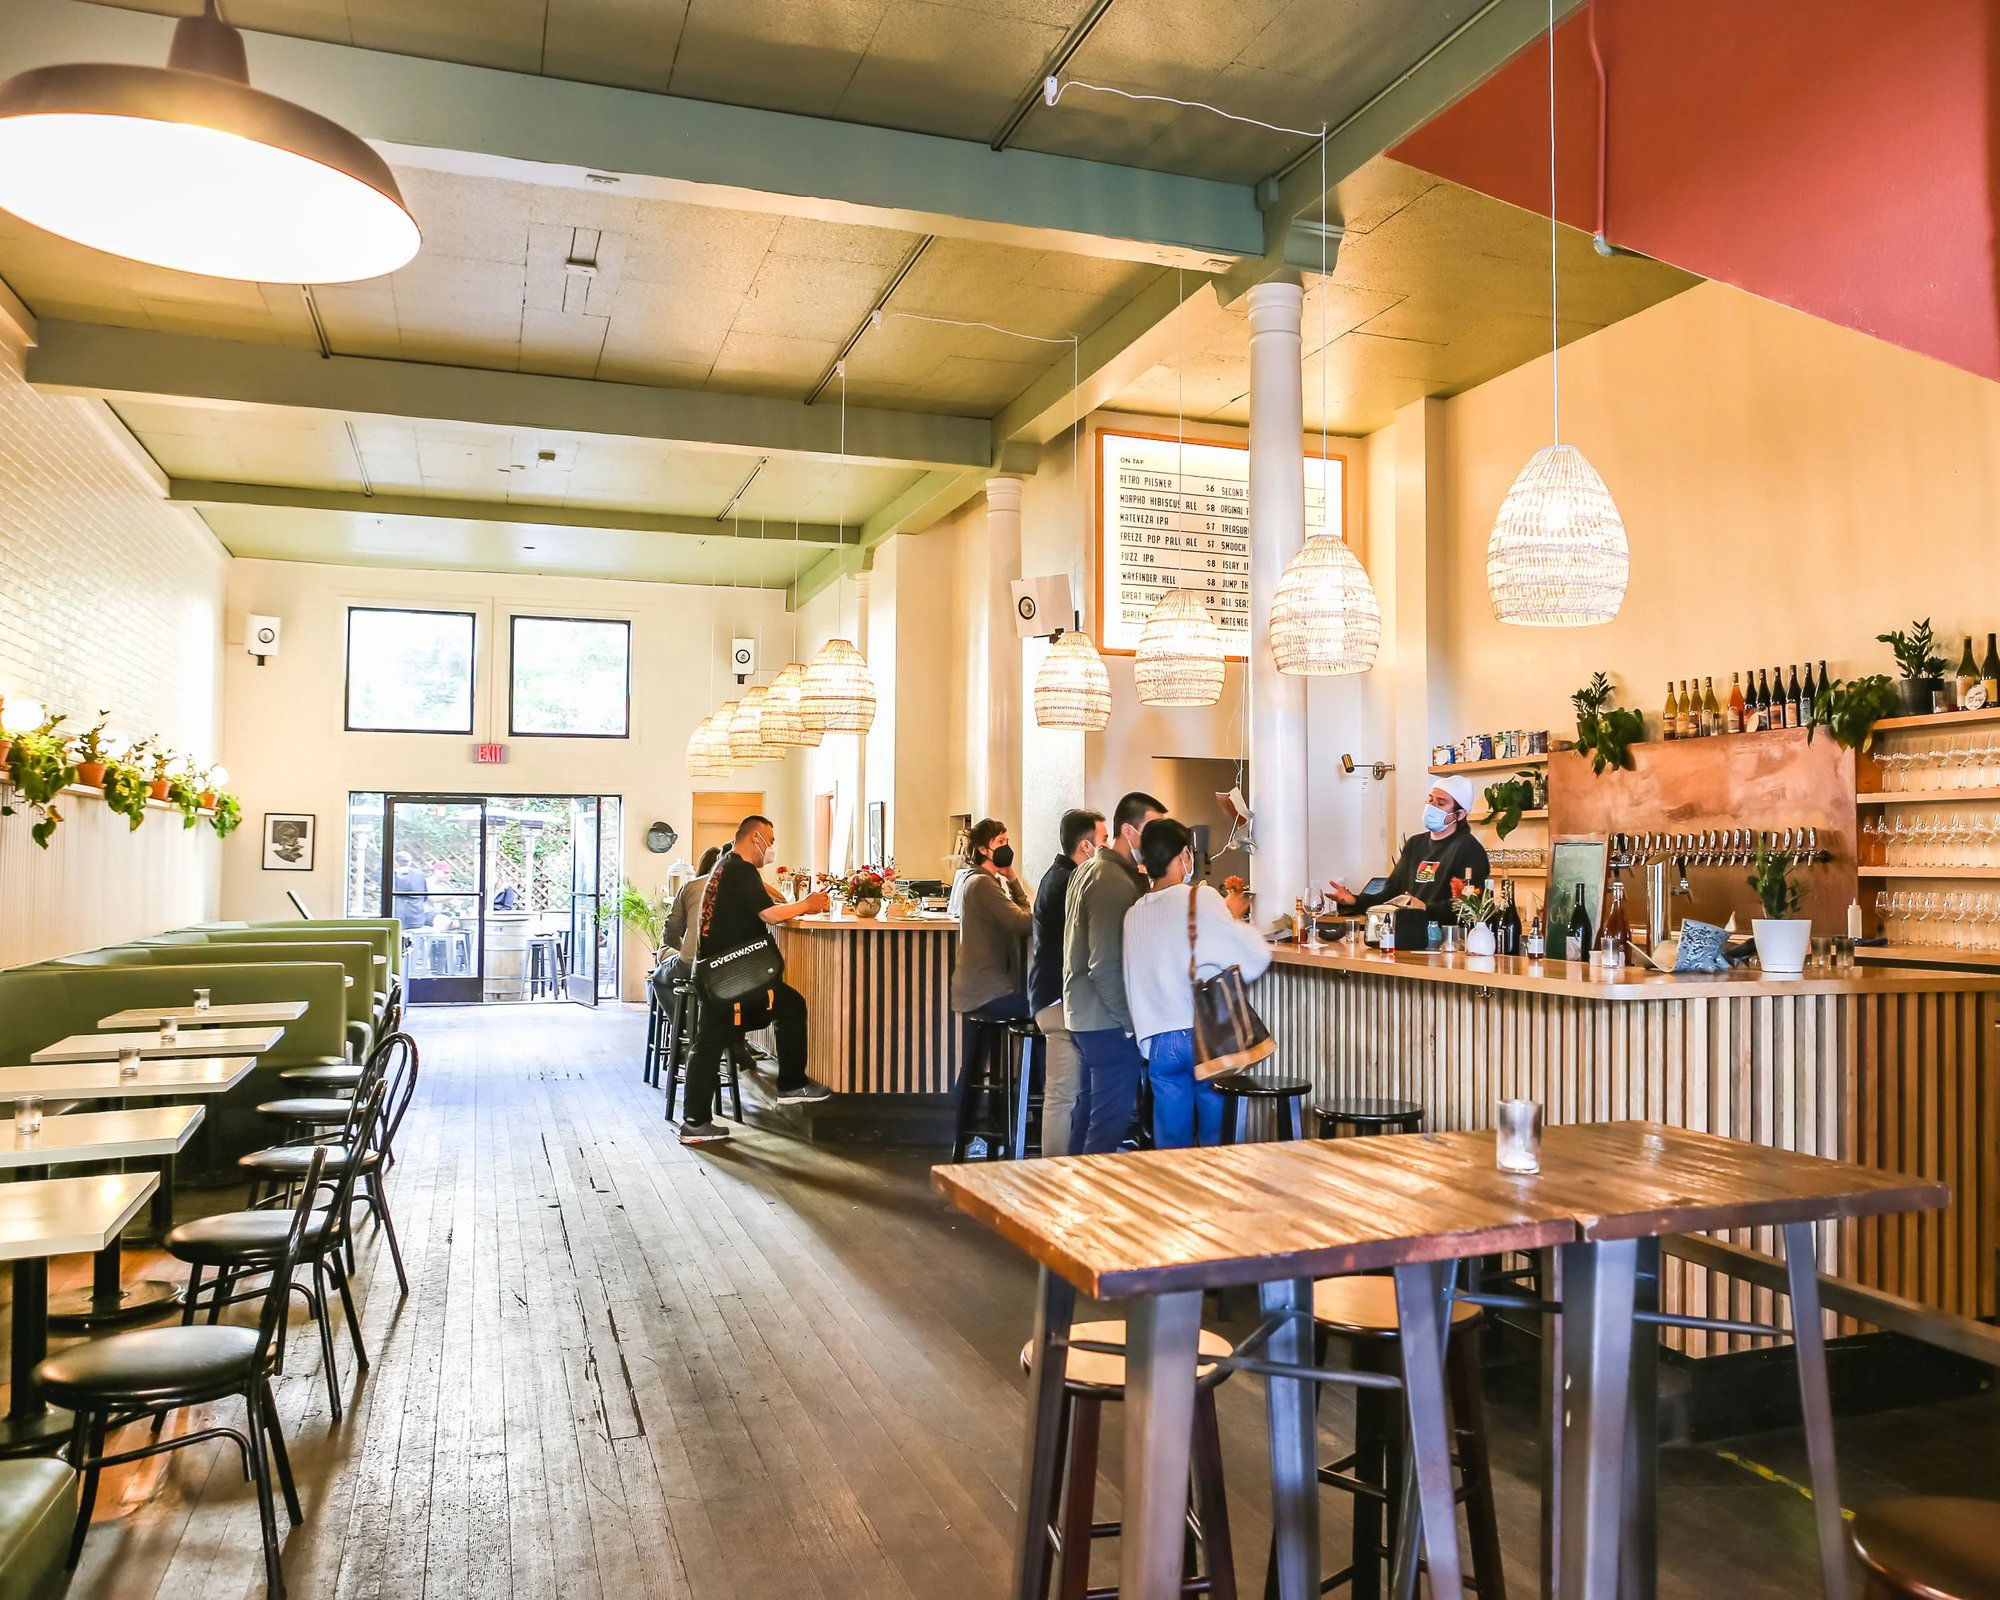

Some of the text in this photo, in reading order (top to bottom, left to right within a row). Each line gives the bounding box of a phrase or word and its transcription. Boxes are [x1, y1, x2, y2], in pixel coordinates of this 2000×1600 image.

[1120, 474, 1215, 493] RETRO PILSNER $6
[1221, 486, 1244, 497] SECOND
[1120, 494, 1216, 512] MORPHO HIBISCUS ALE $8
[1120, 513, 1215, 531] MATEVEZA IPA $7
[1222, 524, 1249, 535] TREASUR
[1120, 532, 1142, 542] FREEZE
[1147, 534, 1161, 544] POP
[1185, 538, 1197, 547] ALE
[1207, 540, 1215, 549] $7
[1221, 541, 1247, 552] SMOOCH
[1121, 551, 1216, 568] FUZZ IPA $8
[1222, 560, 1240, 571] ISLAY
[1122, 571, 1216, 587] WAYFINDER HELL $8
[1222, 579, 1238, 589] JUMP
[1121, 590, 1142, 600] GREAT
[1205, 596, 1215, 604] $8
[1221, 597, 1232, 607] ALL
[478, 744, 503, 762] EXIT
[709, 939, 769, 969] OVERWATCH
